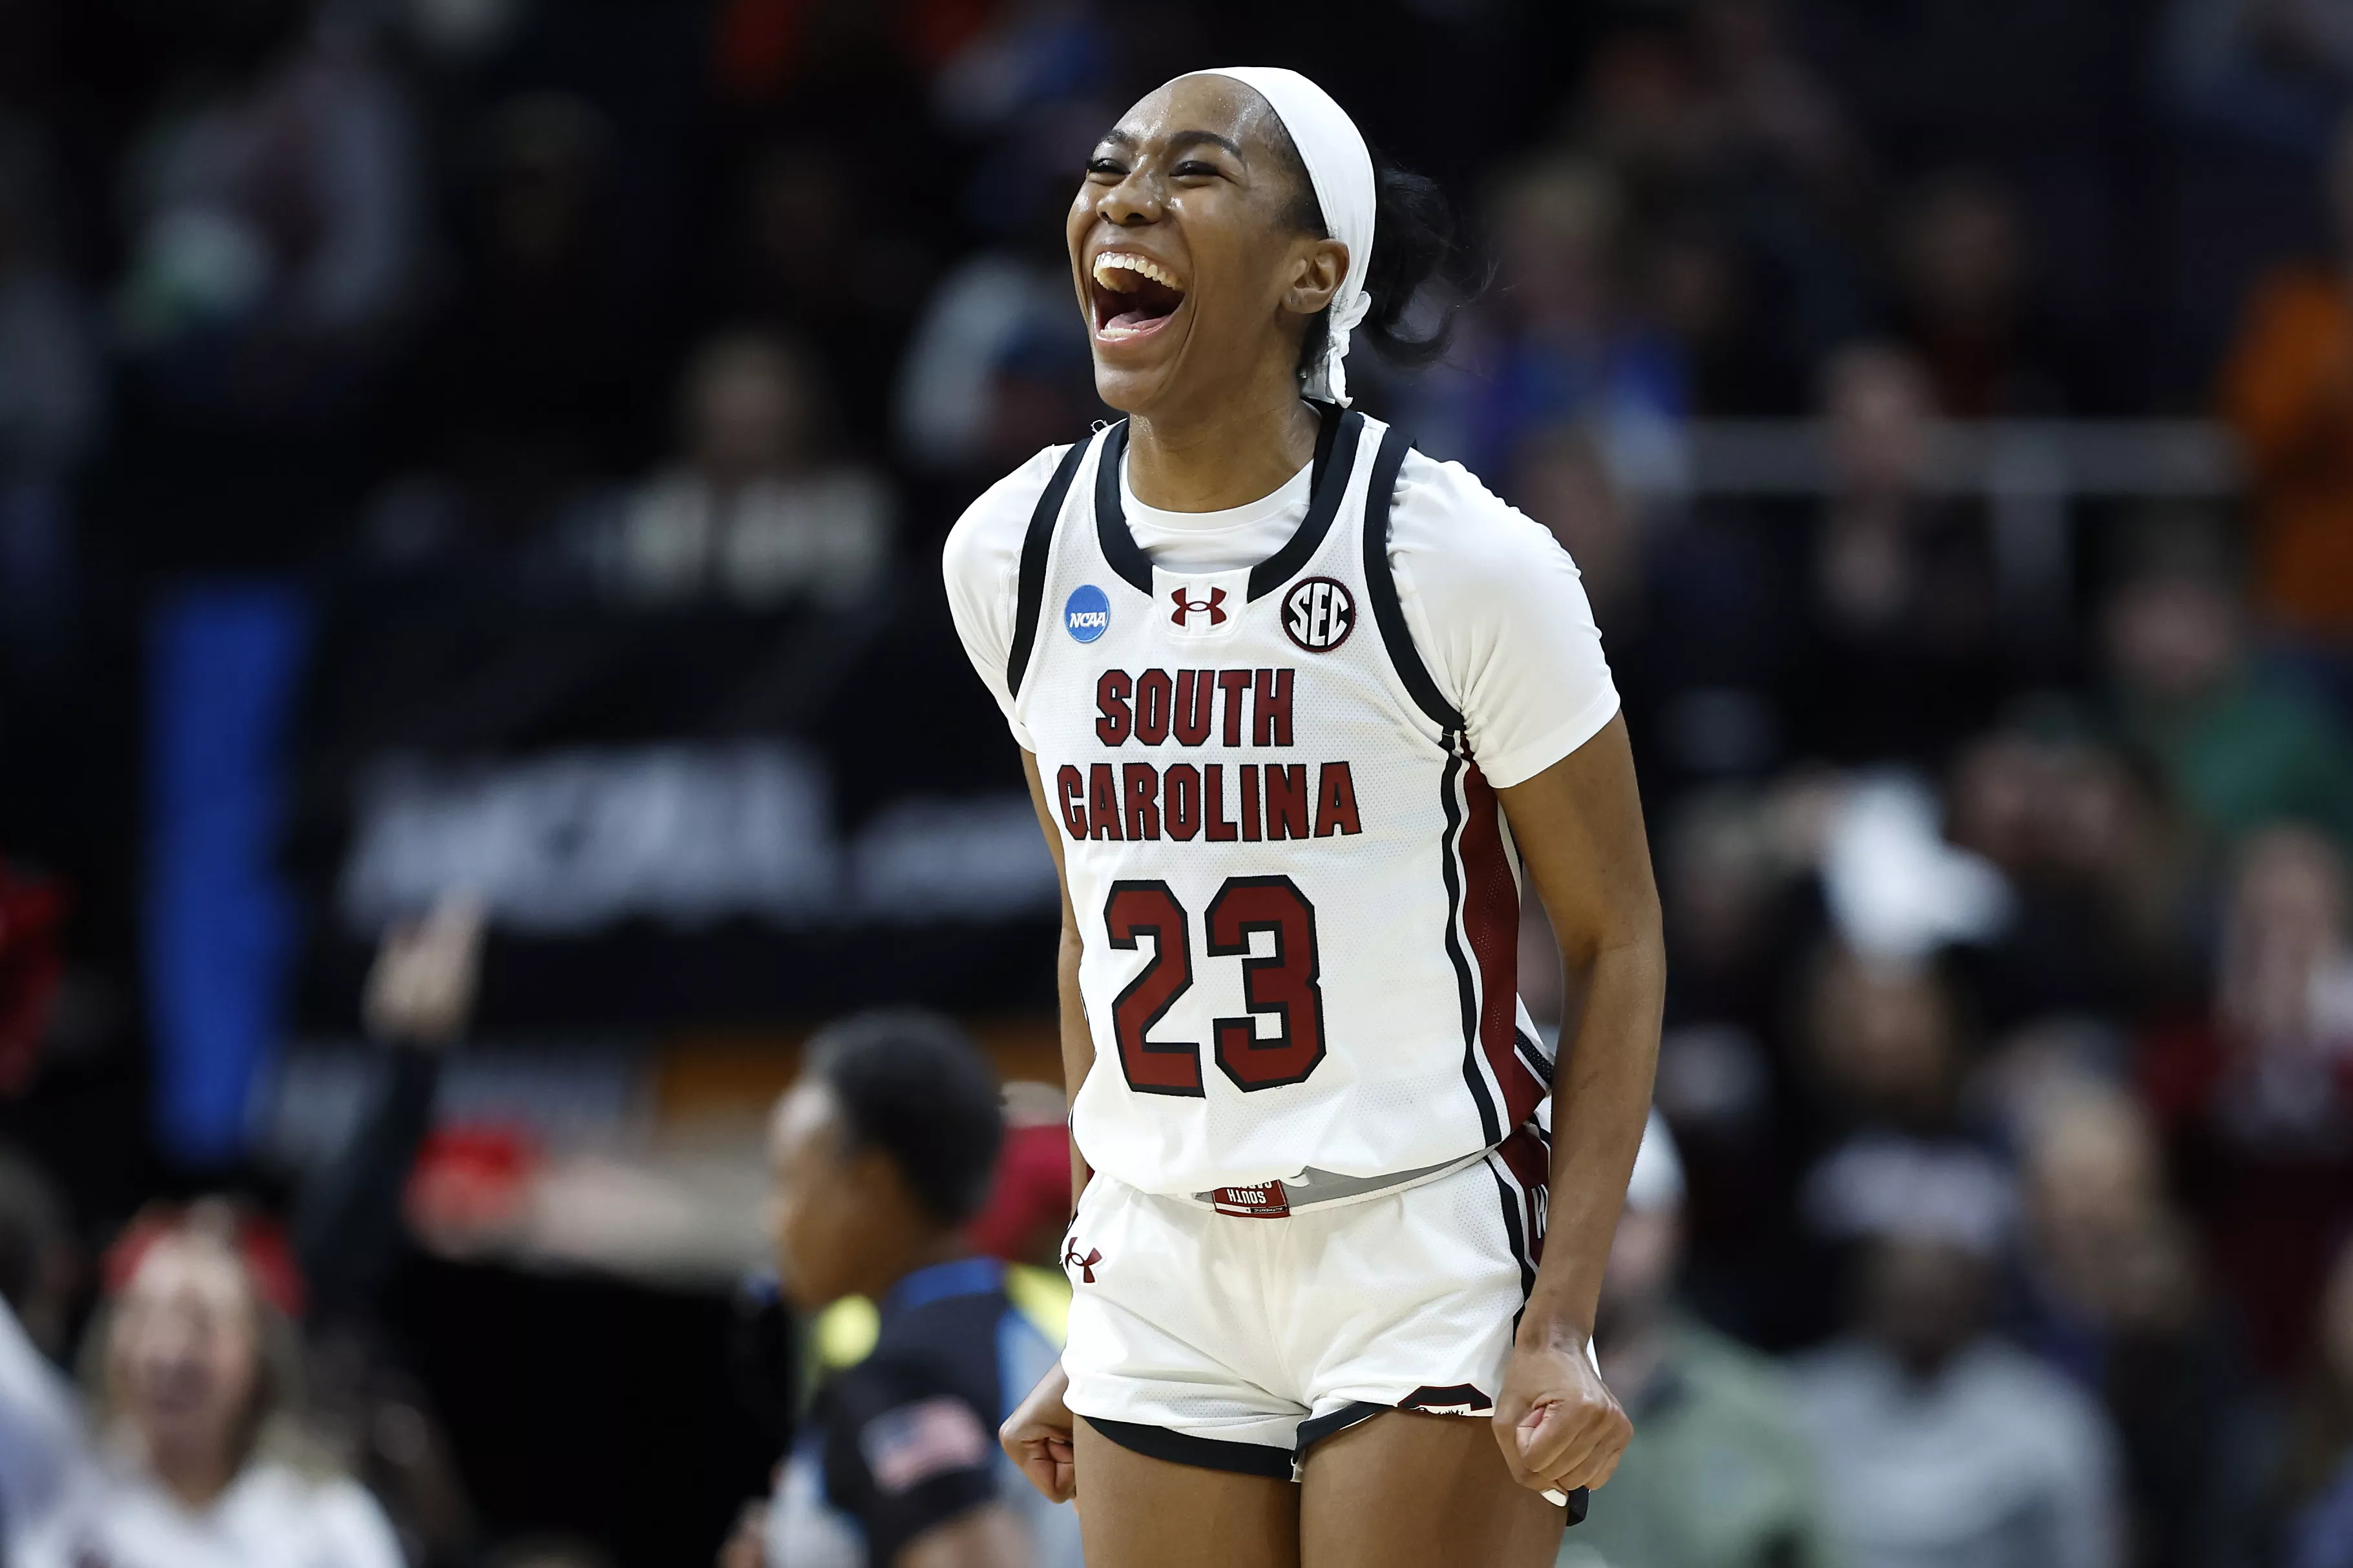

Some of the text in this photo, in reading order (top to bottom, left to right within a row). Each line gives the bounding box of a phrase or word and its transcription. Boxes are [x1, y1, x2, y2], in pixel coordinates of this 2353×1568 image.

[1069, 611, 1107, 629] NCAA
[1289, 582, 1349, 647] SEC
[1096, 668, 1295, 747] SOUTH
[1056, 760, 1363, 842] CAROLINA
[1103, 874, 1328, 1099] 23
[1226, 1188, 1267, 1204] SOUTH
